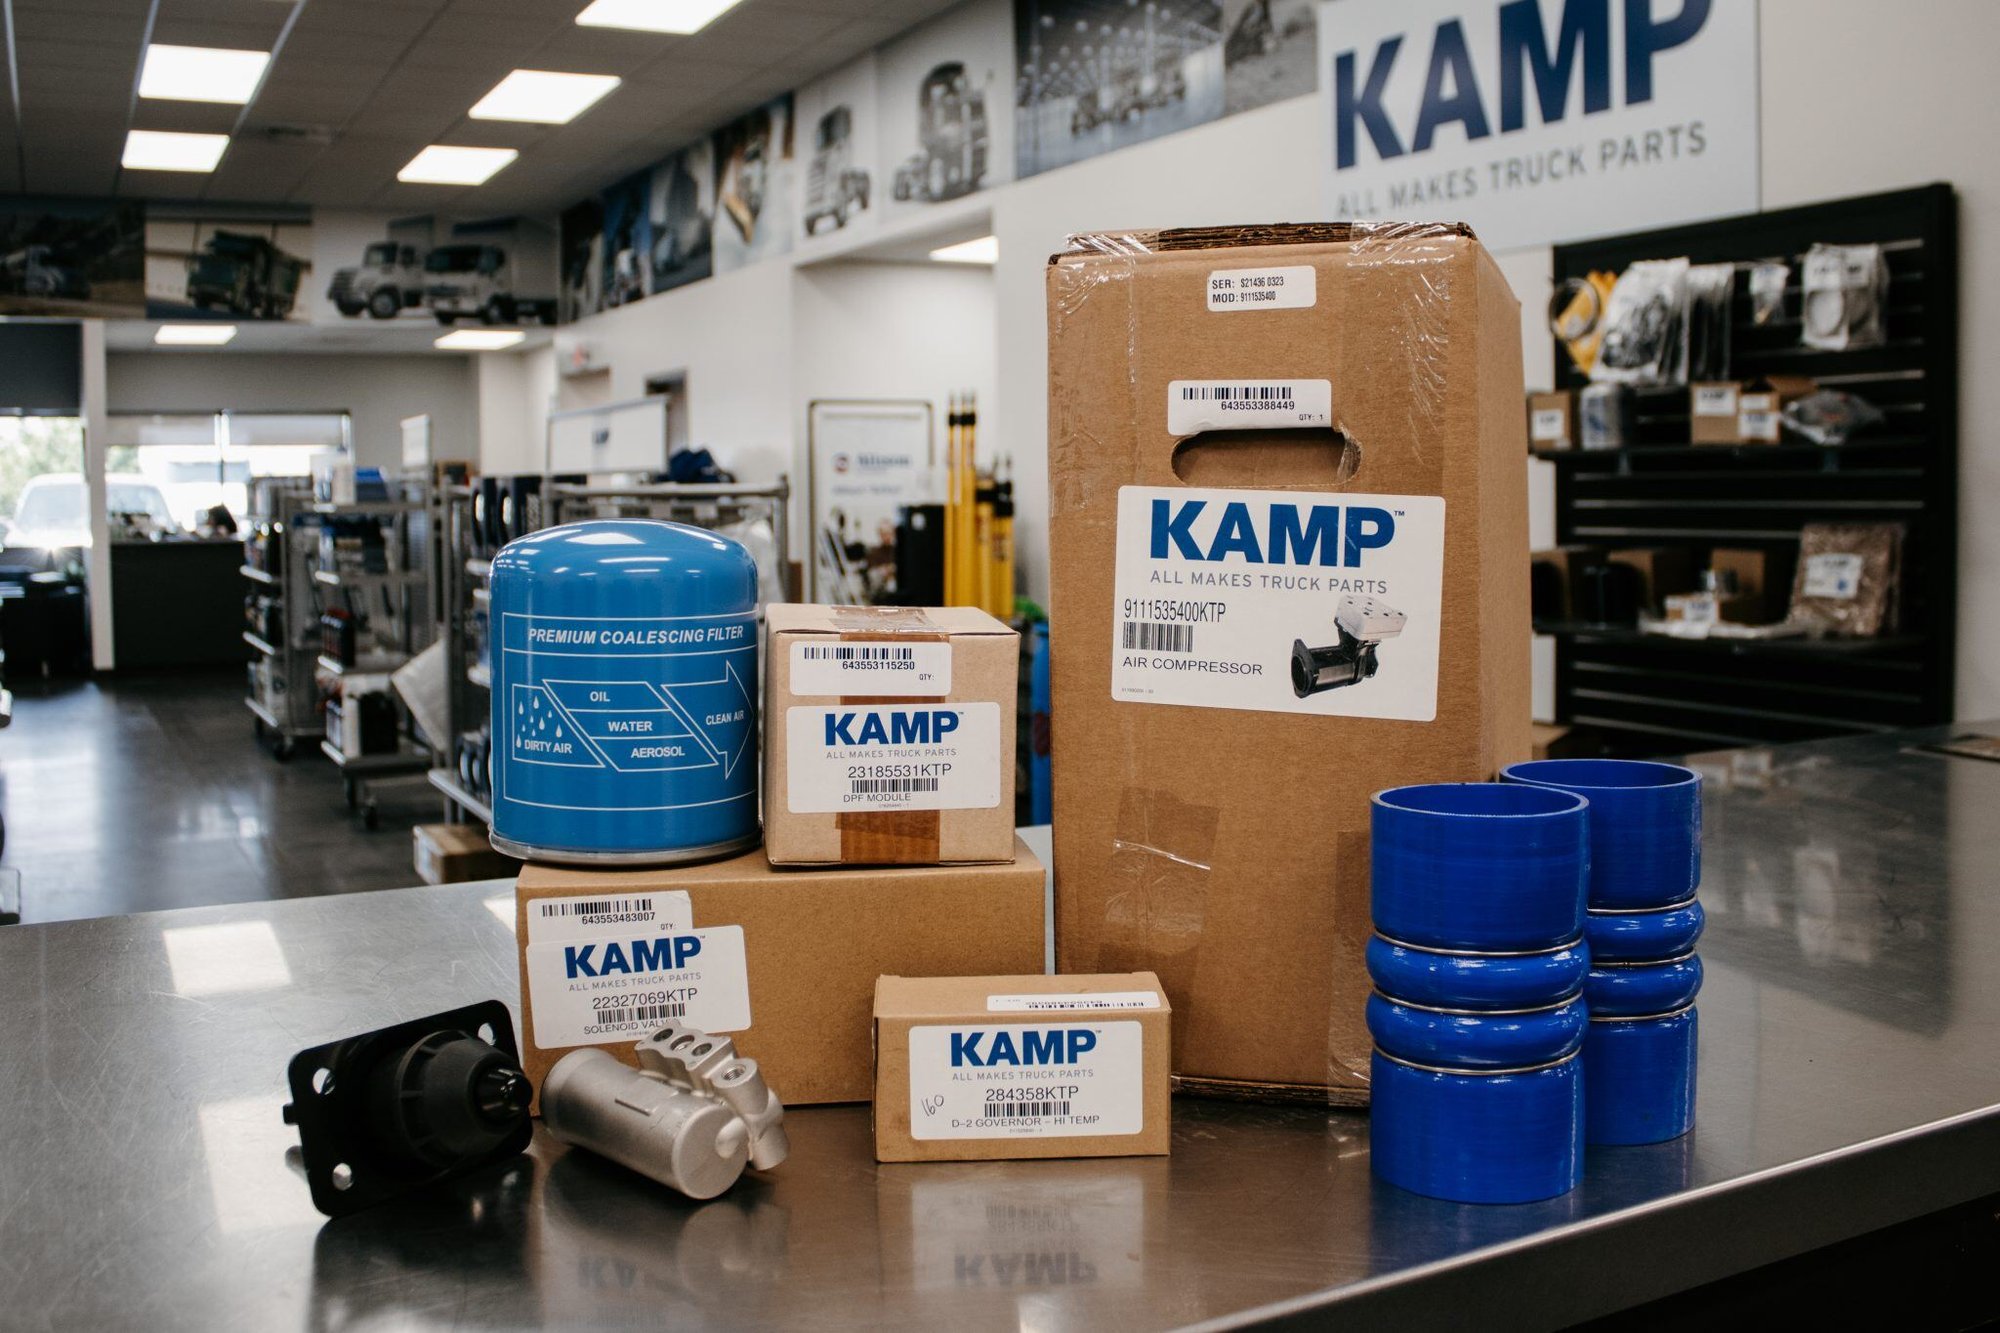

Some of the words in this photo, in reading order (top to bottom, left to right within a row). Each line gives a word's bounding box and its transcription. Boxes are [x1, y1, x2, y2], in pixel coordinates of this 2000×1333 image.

[1335, 0, 1710, 170] KAMP
[1337, 188, 1379, 218] ALL
[1389, 166, 1478, 210] MAKES
[1489, 146, 1586, 194] TRUCK
[1601, 121, 1707, 169] PARTS
[1212, 279, 1235, 289] SER:
[1267, 275, 1284, 287] 0323
[1212, 292, 1239, 303] MOD:
[1221, 400, 1295, 411] 643553388449
[1150, 499, 1396, 568] KAMP
[1150, 569, 1183, 585] ALL
[1191, 572, 1252, 588] MAKES
[1260, 575, 1320, 591] TRUCK
[1329, 578, 1388, 594] PARTS
[1124, 598, 1226, 622] 9111535400KTP
[528, 628, 596, 644] PREMIUM
[600, 628, 704, 645] COALESCING
[706, 625, 744, 642] FILTER
[842, 661, 915, 670] 643553115250
[1123, 656, 1148, 669] AIR
[1152, 657, 1263, 676] COMPRESSOR
[589, 691, 611, 702] OIL
[705, 712, 732, 725] CLEAN
[733, 710, 745, 722] AIR
[608, 721, 653, 732] WATER
[825, 710, 959, 746] KAMP
[524, 739, 552, 752] DIRTY
[553, 742, 572, 754] AIR
[631, 746, 685, 758] AEROSOL
[826, 751, 845, 759] ALL
[849, 750, 884, 758] MAKES
[888, 749, 921, 757] TRUCK
[925, 748, 957, 757] PARTS
[848, 763, 952, 778] 23185531KTP
[843, 794, 864, 803] DPF
[867, 792, 911, 802] MODULE
[582, 912, 656, 925] 643553483007
[564, 935, 702, 979] KAMP
[569, 982, 589, 992] ALL
[592, 979, 628, 989] MAKES
[631, 976, 665, 986] TRUCK
[669, 972, 702, 983] PARTS
[592, 988, 698, 1010] 22327069KTP
[584, 1021, 639, 1035] SOLENOID
[950, 1029, 1097, 1068] KAMP
[952, 1072, 973, 1081] ALL
[977, 1071, 1015, 1080] MAKES
[1019, 1070, 1055, 1079] TRUCK
[1059, 1069, 1094, 1078] PARTS
[986, 1086, 1079, 1102] 284358KTP
[975, 1117, 1041, 1128] GOVERNOR
[1054, 1116, 1066, 1126] HI
[1069, 1115, 1100, 1125] TEMP
